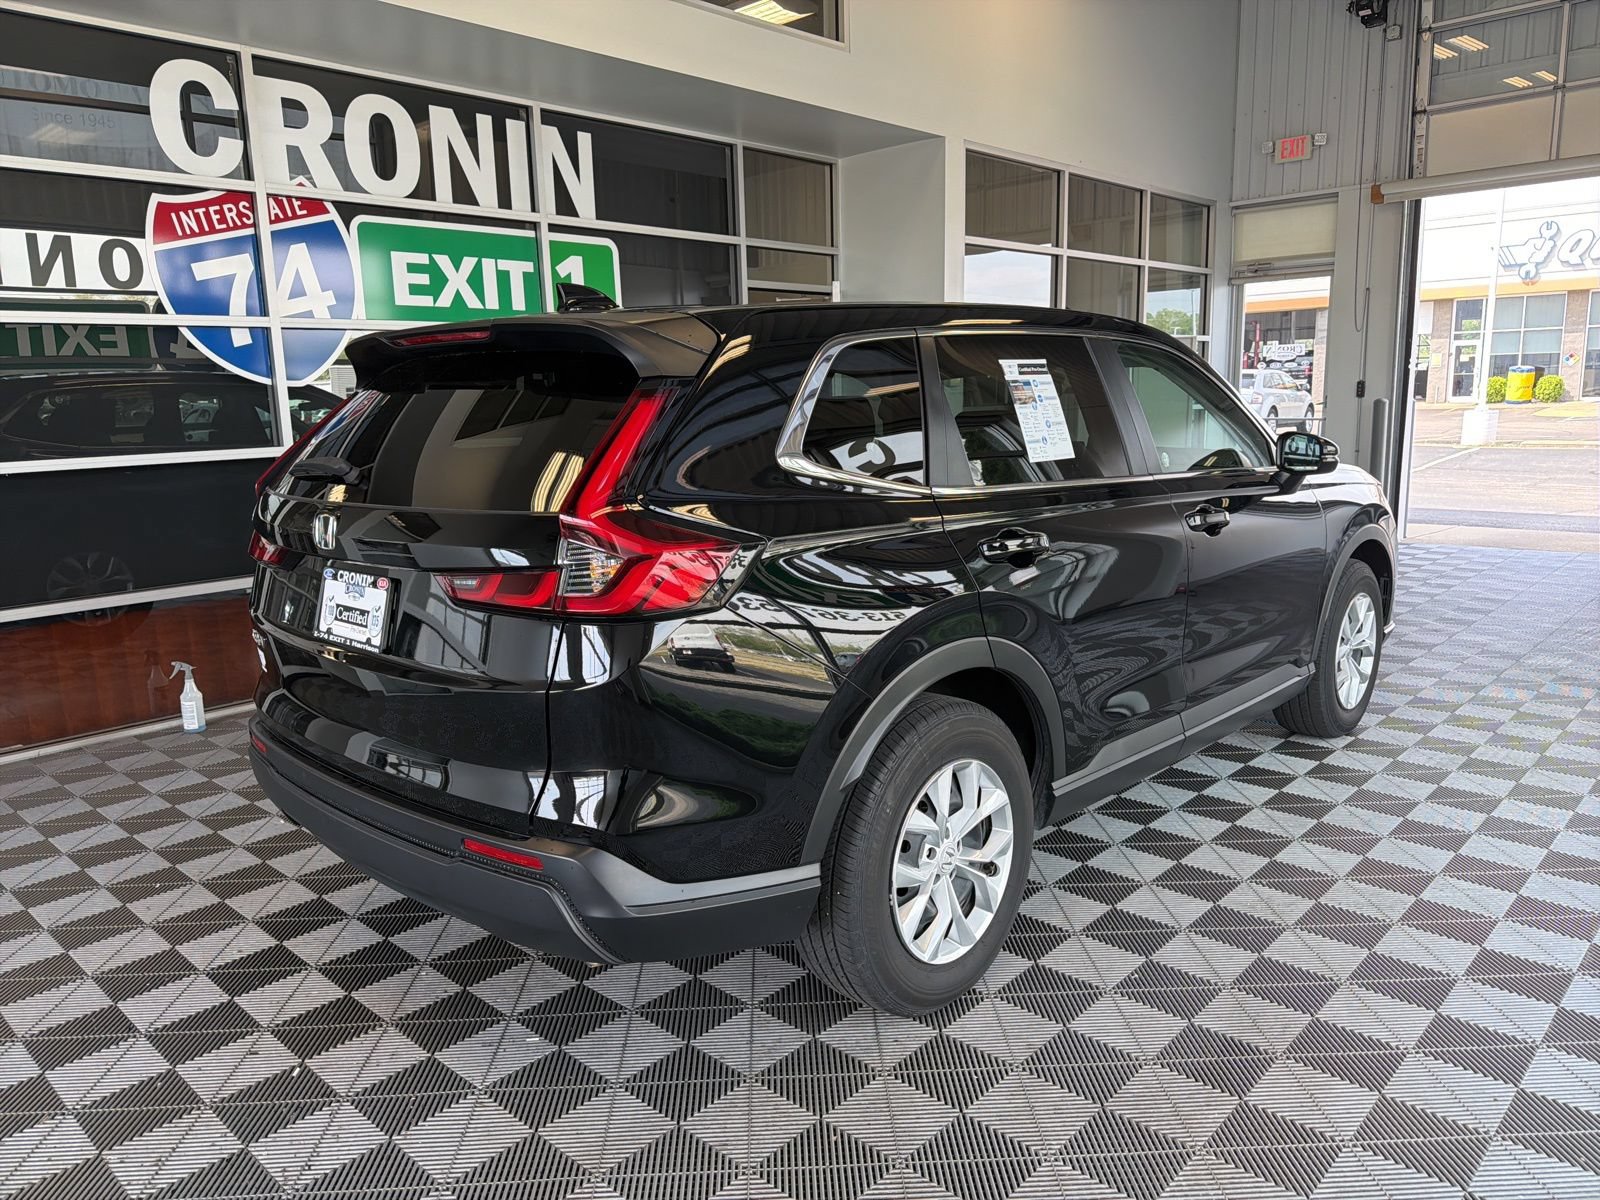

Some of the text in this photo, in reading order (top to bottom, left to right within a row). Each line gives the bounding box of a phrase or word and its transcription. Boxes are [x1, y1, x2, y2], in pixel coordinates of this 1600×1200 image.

[149, 58, 596, 220] CRONIN
[1281, 135, 1307, 160] EXIT
[170, 195, 307, 237] INTERSATE
[191, 242, 337, 347] 74
[390, 250, 534, 311] EXIT
[338, 570, 374, 586] CRONIN
[337, 607, 368, 625] Certified
[329, 634, 345, 644] EXIT
[352, 640, 380, 653] Harrison
